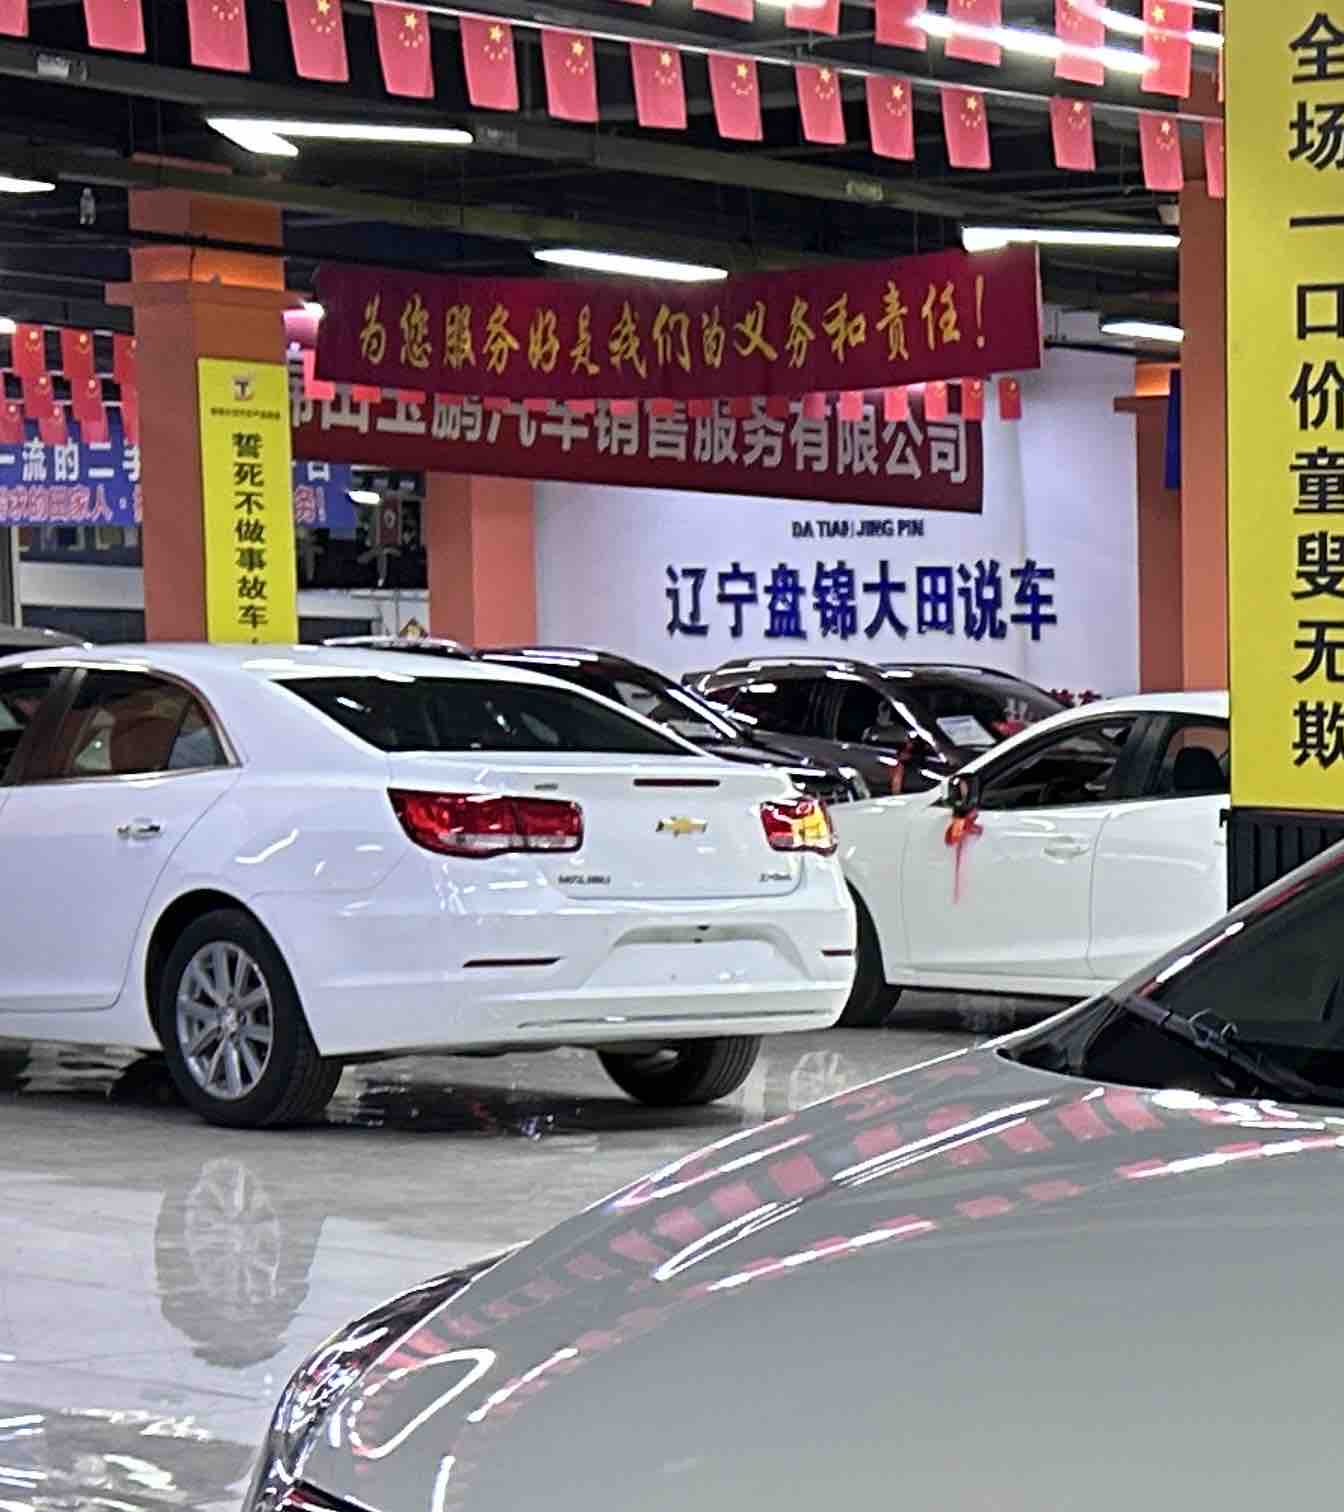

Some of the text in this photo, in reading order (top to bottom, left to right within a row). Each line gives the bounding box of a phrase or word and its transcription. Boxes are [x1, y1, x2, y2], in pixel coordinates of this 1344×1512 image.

[232, 432, 269, 644] 誓死不做事故车
[665, 559, 1058, 641] 辽宁盘锦大田说车
